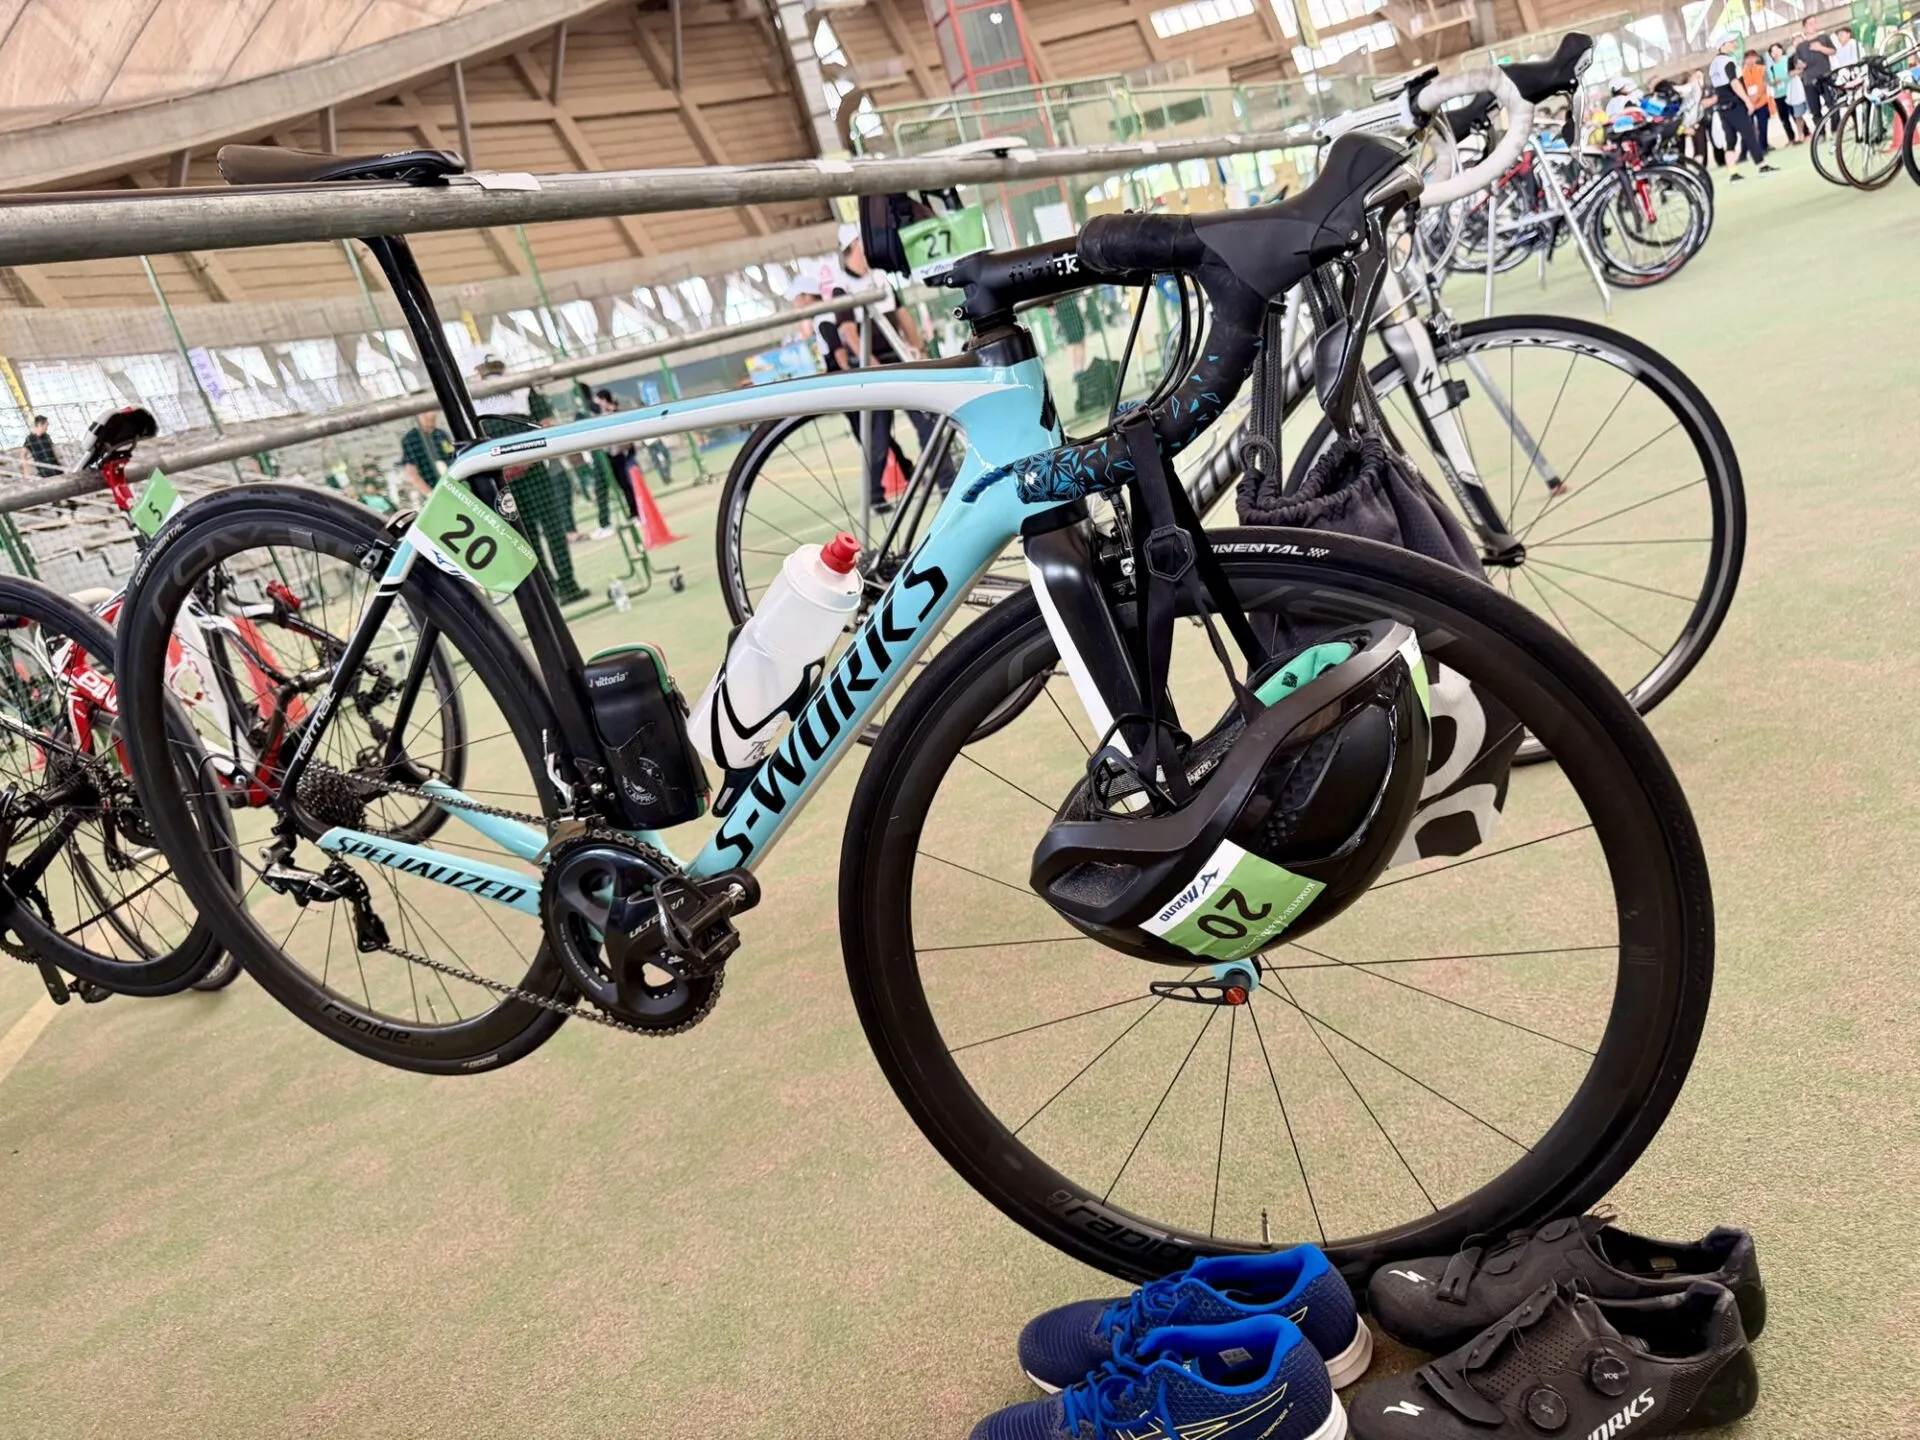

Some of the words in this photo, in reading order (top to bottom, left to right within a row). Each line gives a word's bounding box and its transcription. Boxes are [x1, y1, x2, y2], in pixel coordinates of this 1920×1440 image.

[924, 231, 951, 258] 27
[148, 502, 162, 522] 5
[135, 522, 187, 587] CONTINENTAL
[439, 514, 498, 570] 20
[1211, 543, 1304, 556] INENTAL
[716, 533, 948, 868] S-WORKS
[338, 836, 527, 903] SPECIALIZED
[1197, 888, 1272, 940] 20
[322, 1001, 411, 1044] rapide
[1065, 1205, 1192, 1259] rapid
[1588, 1387, 1656, 1440] ORKS
